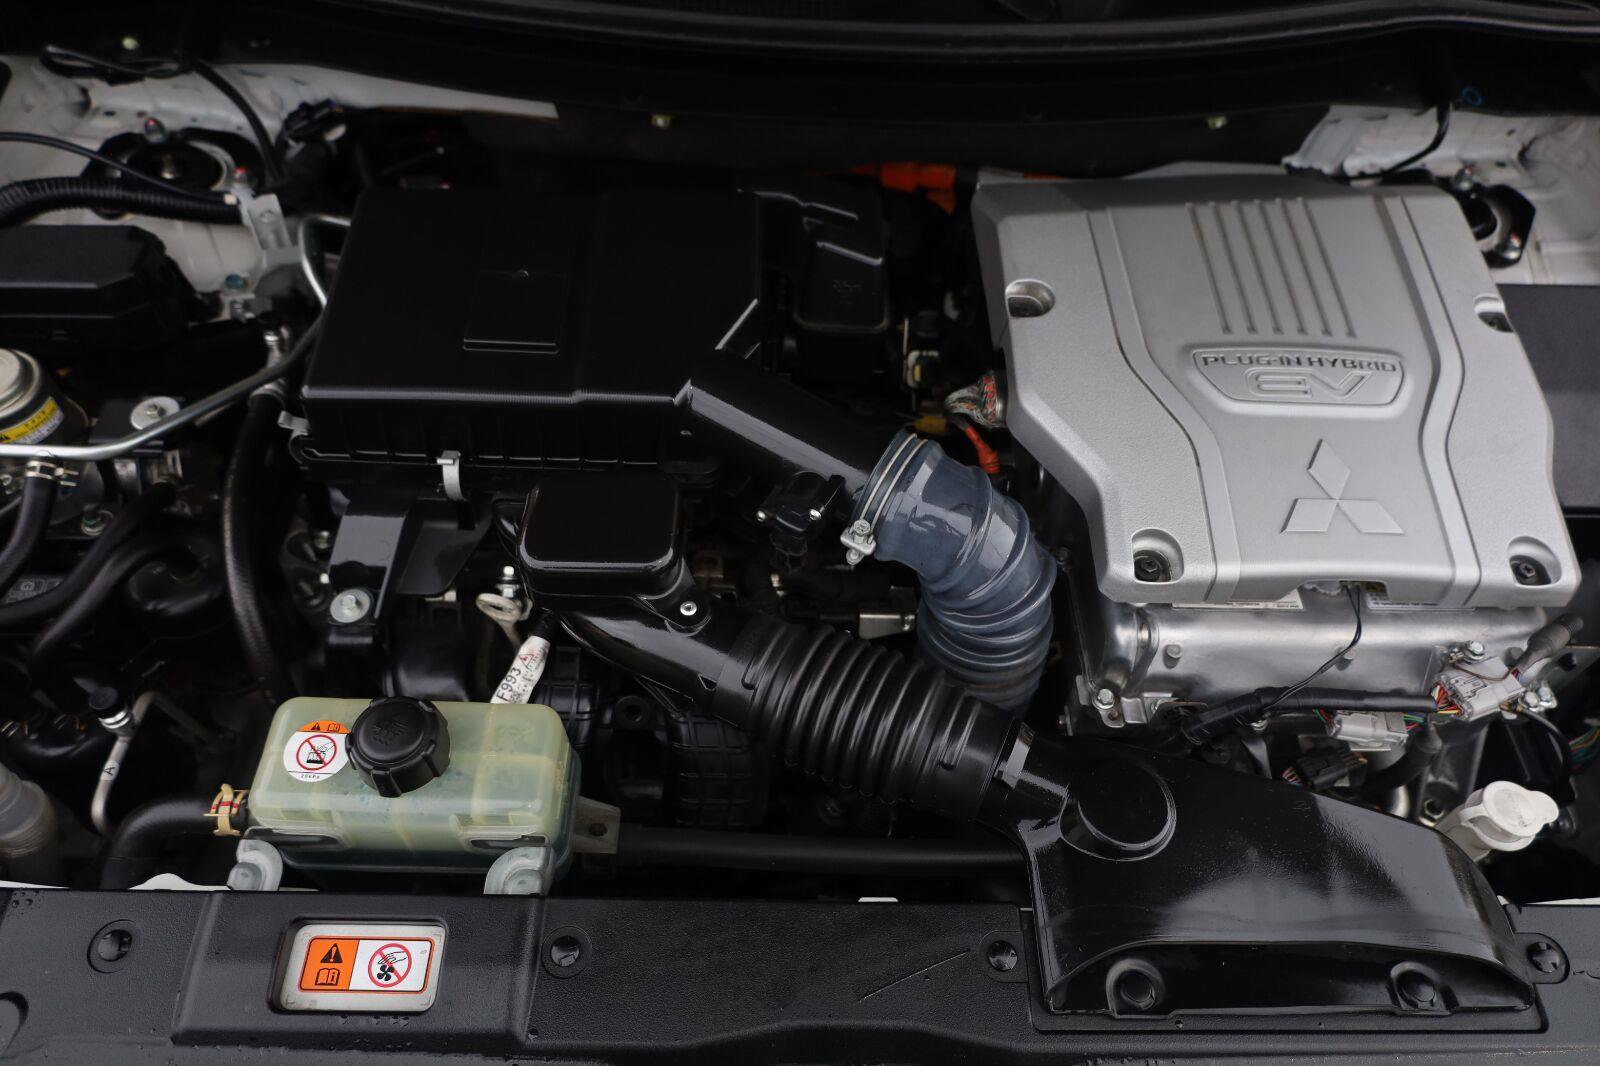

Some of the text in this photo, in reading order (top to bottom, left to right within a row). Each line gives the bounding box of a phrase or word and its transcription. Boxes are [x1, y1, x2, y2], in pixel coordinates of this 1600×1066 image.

[1202, 354, 1398, 373] PLUG-IN HYBRID
[1245, 367, 1372, 399] EV
